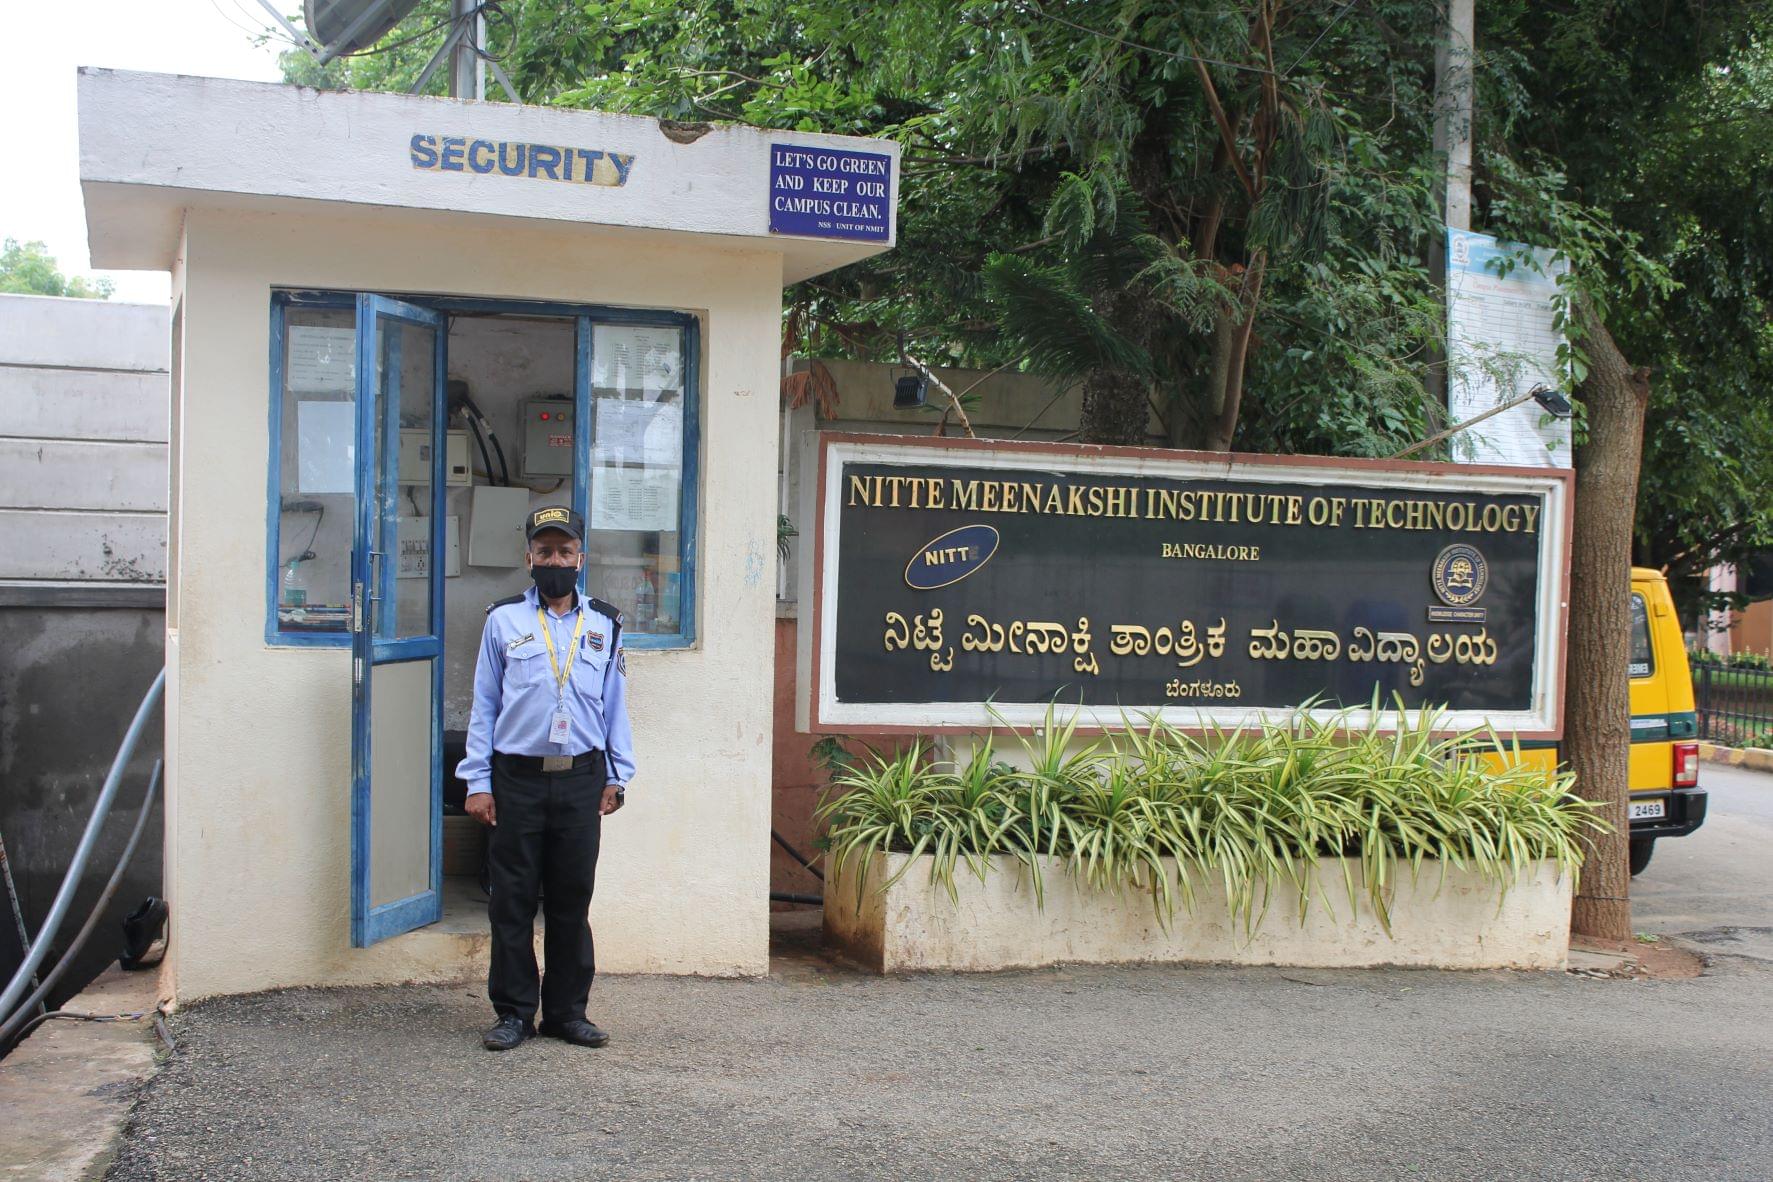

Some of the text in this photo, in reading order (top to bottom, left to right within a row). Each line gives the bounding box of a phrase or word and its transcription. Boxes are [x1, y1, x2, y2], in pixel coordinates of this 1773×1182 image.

[410, 134, 635, 187] SECURITY
[776, 151, 886, 176] LET'S GO GREEN
[775, 174, 885, 198] AND KEEP OUR
[775, 196, 882, 219] CAMPUS CLEAN.
[818, 221, 885, 233] NSS UNIT OF NMIT
[848, 475, 1541, 534] NITTE MEENAKSHI INSTITUTE OF TECHNOLOGY
[1161, 543, 1260, 561] BANGALORE
[884, 608, 953, 672] ನಿಟ್ಟೆ
[961, 614, 1101, 676] ಮೀನಾಕ್ಷಿ
[1110, 616, 1226, 667] ತಾಂತ್ರಿಕ
[1165, 678, 1241, 698] ಬೆಂಗಳೂರು
[1635, 804, 1661, 816] 2469
